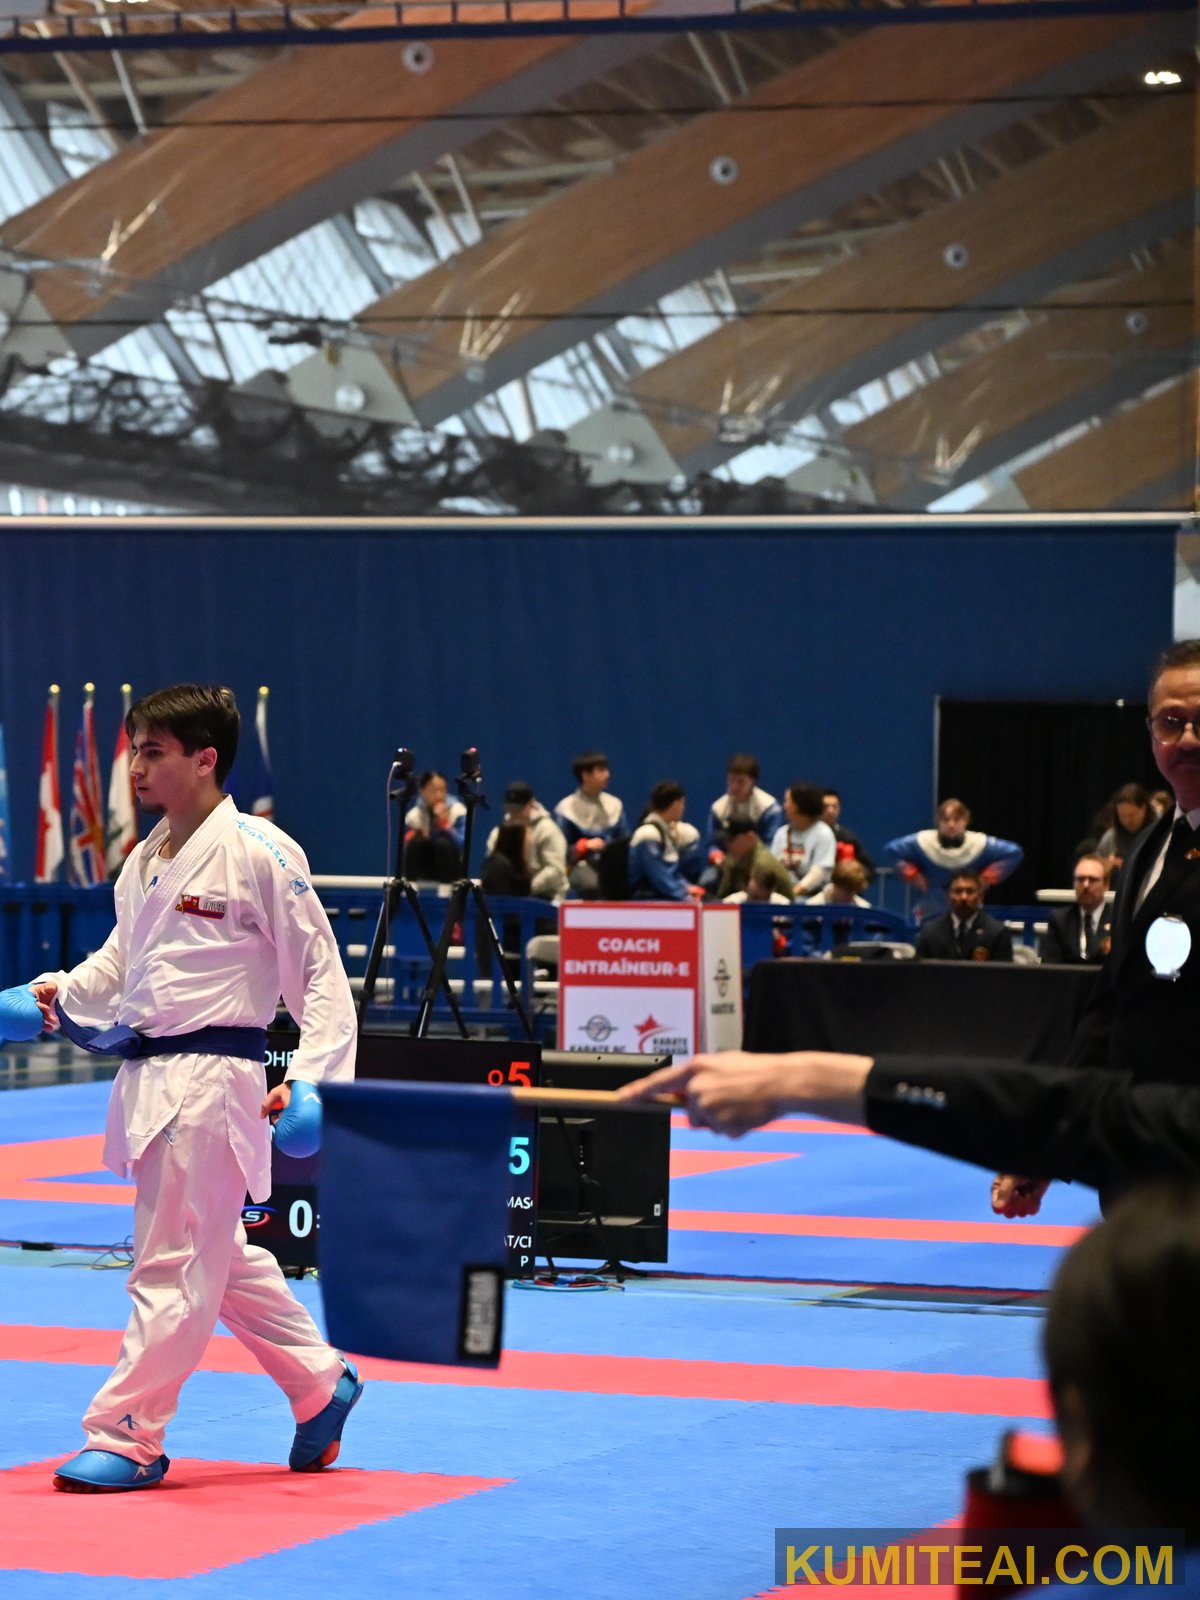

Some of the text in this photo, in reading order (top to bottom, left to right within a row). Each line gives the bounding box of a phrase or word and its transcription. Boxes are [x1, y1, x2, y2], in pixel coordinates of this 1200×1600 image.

[598, 937, 660, 953] COACH
[508, 1061, 532, 1087] 5
[508, 1136, 530, 1175] 5
